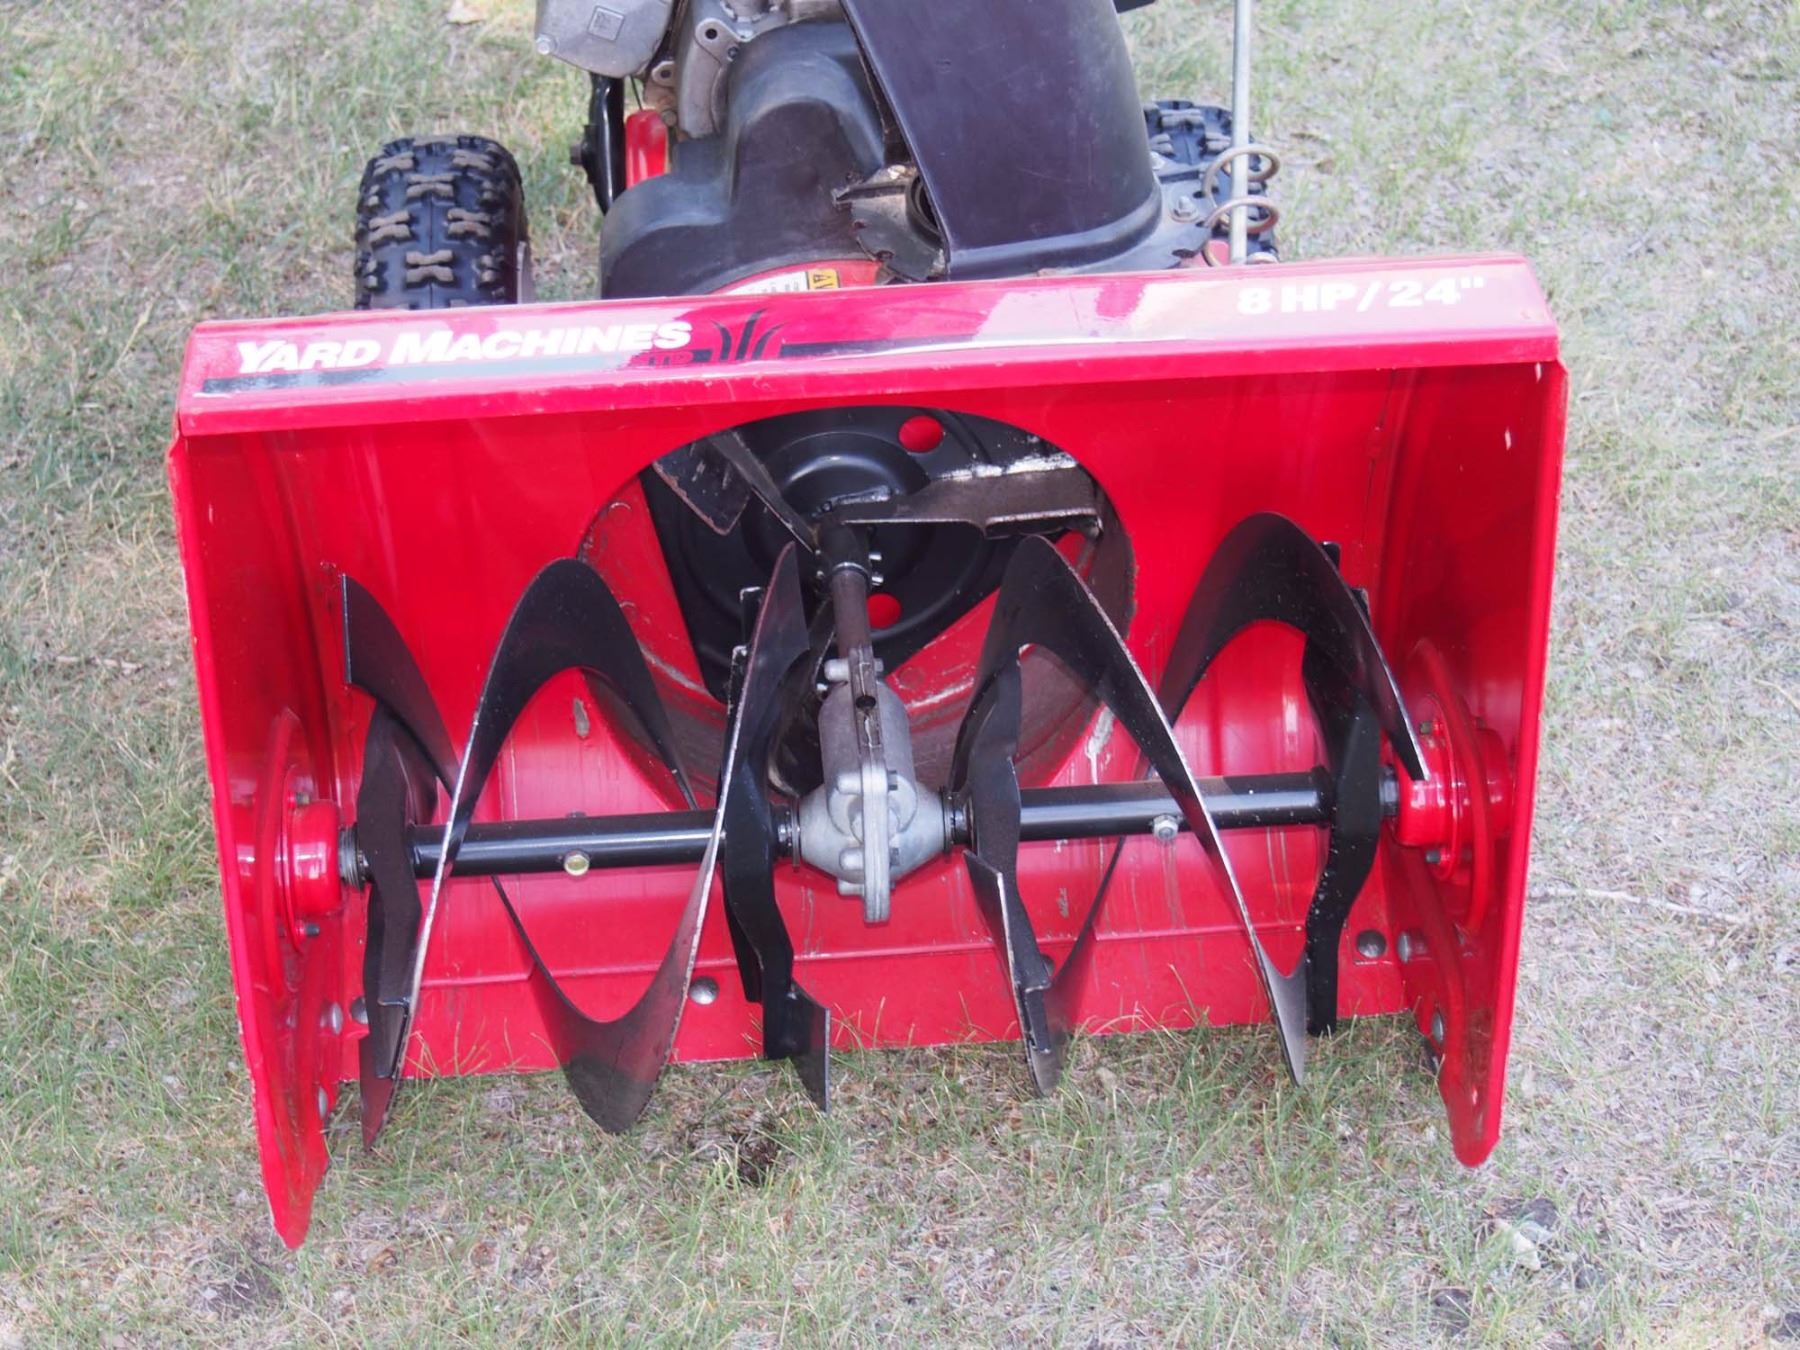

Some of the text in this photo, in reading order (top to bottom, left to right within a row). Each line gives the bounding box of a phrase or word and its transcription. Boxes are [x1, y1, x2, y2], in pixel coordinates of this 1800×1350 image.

[1237, 287, 1272, 315] 8
[237, 320, 692, 374] YARD MACHINES
